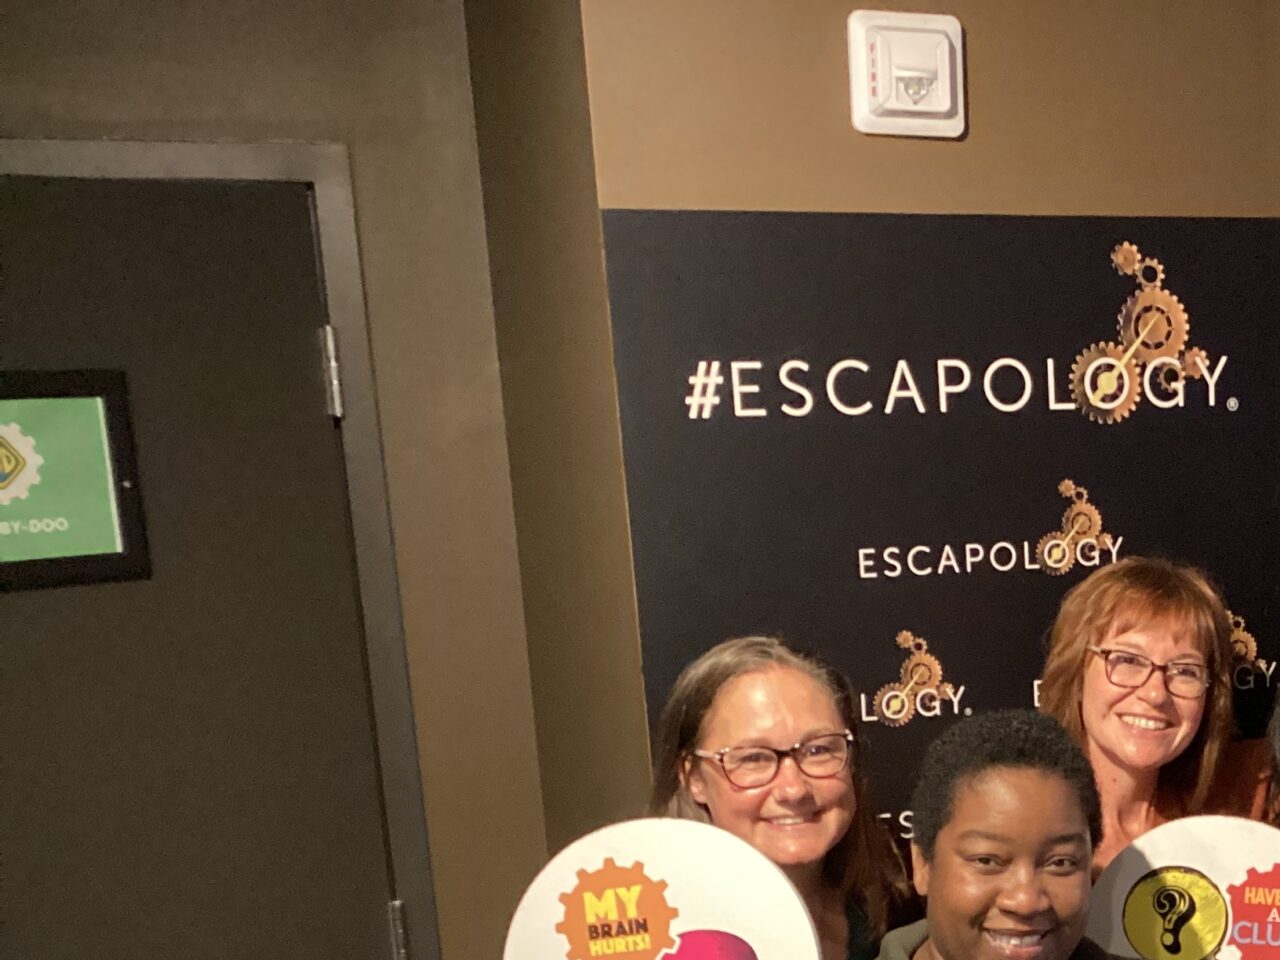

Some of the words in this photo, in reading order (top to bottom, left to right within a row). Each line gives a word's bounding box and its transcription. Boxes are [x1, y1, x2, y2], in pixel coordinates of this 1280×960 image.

[857, 535, 1124, 579] ESCAPOLOGY
[582, 884, 643, 924] MY
[587, 917, 650, 941] BRAIN
[588, 932, 653, 957] HURTS!
